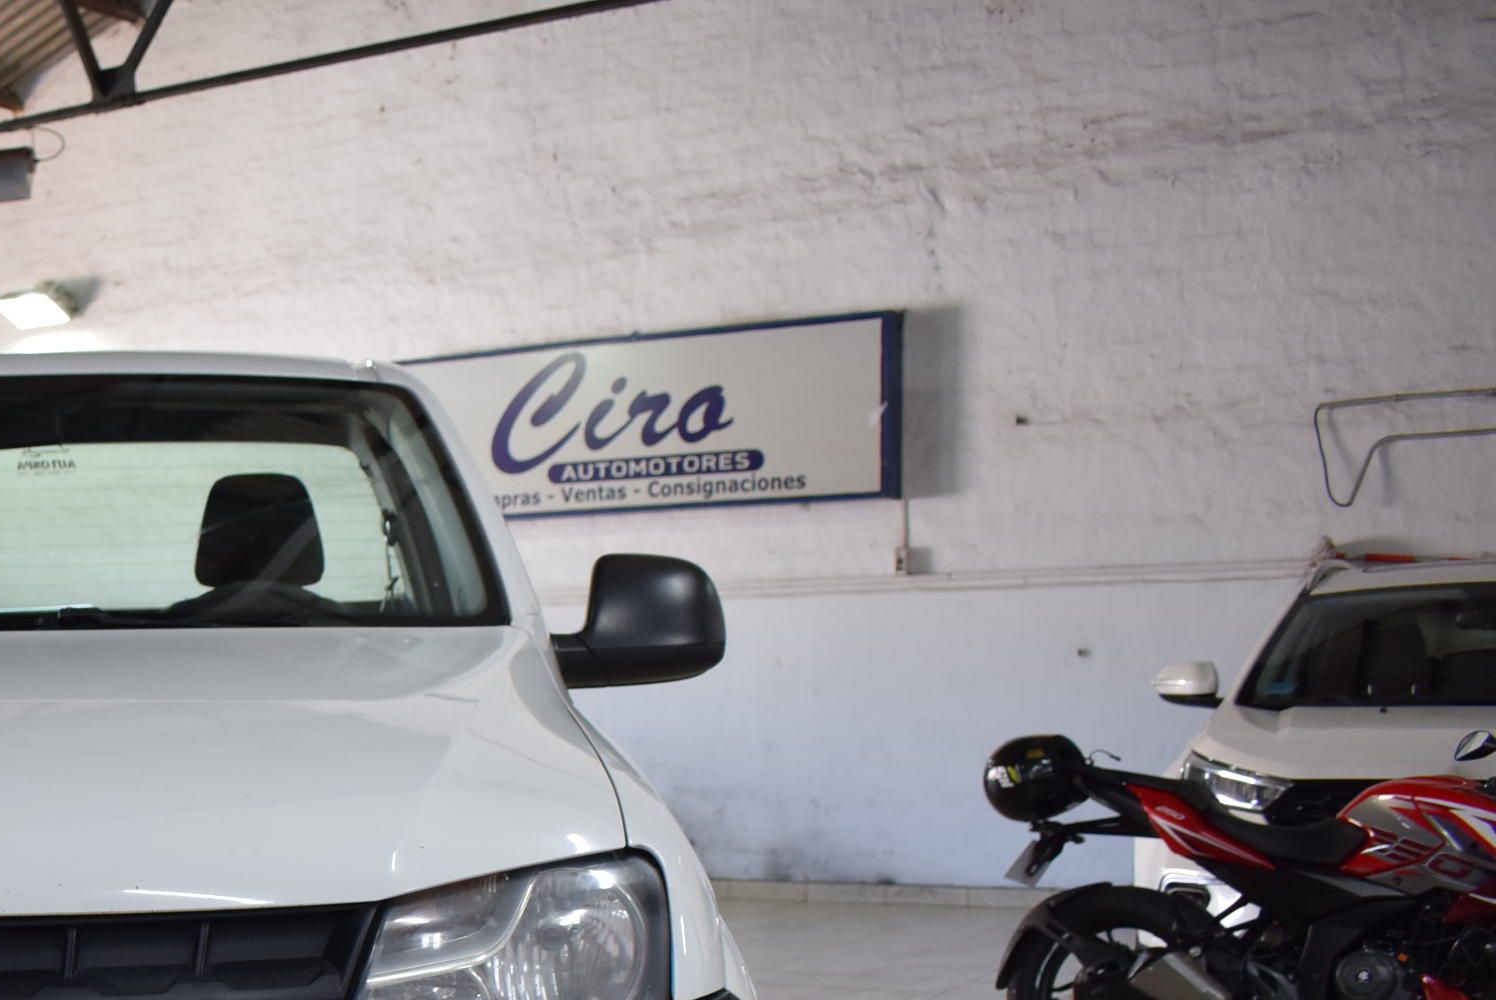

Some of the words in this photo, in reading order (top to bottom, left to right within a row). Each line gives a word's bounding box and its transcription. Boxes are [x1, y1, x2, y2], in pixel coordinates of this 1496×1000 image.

[491, 352, 734, 475] Ciro
[560, 452, 751, 483] AUTOMOTORES
[561, 486, 627, 503] Ventas
[648, 474, 807, 498] Consignaciones
